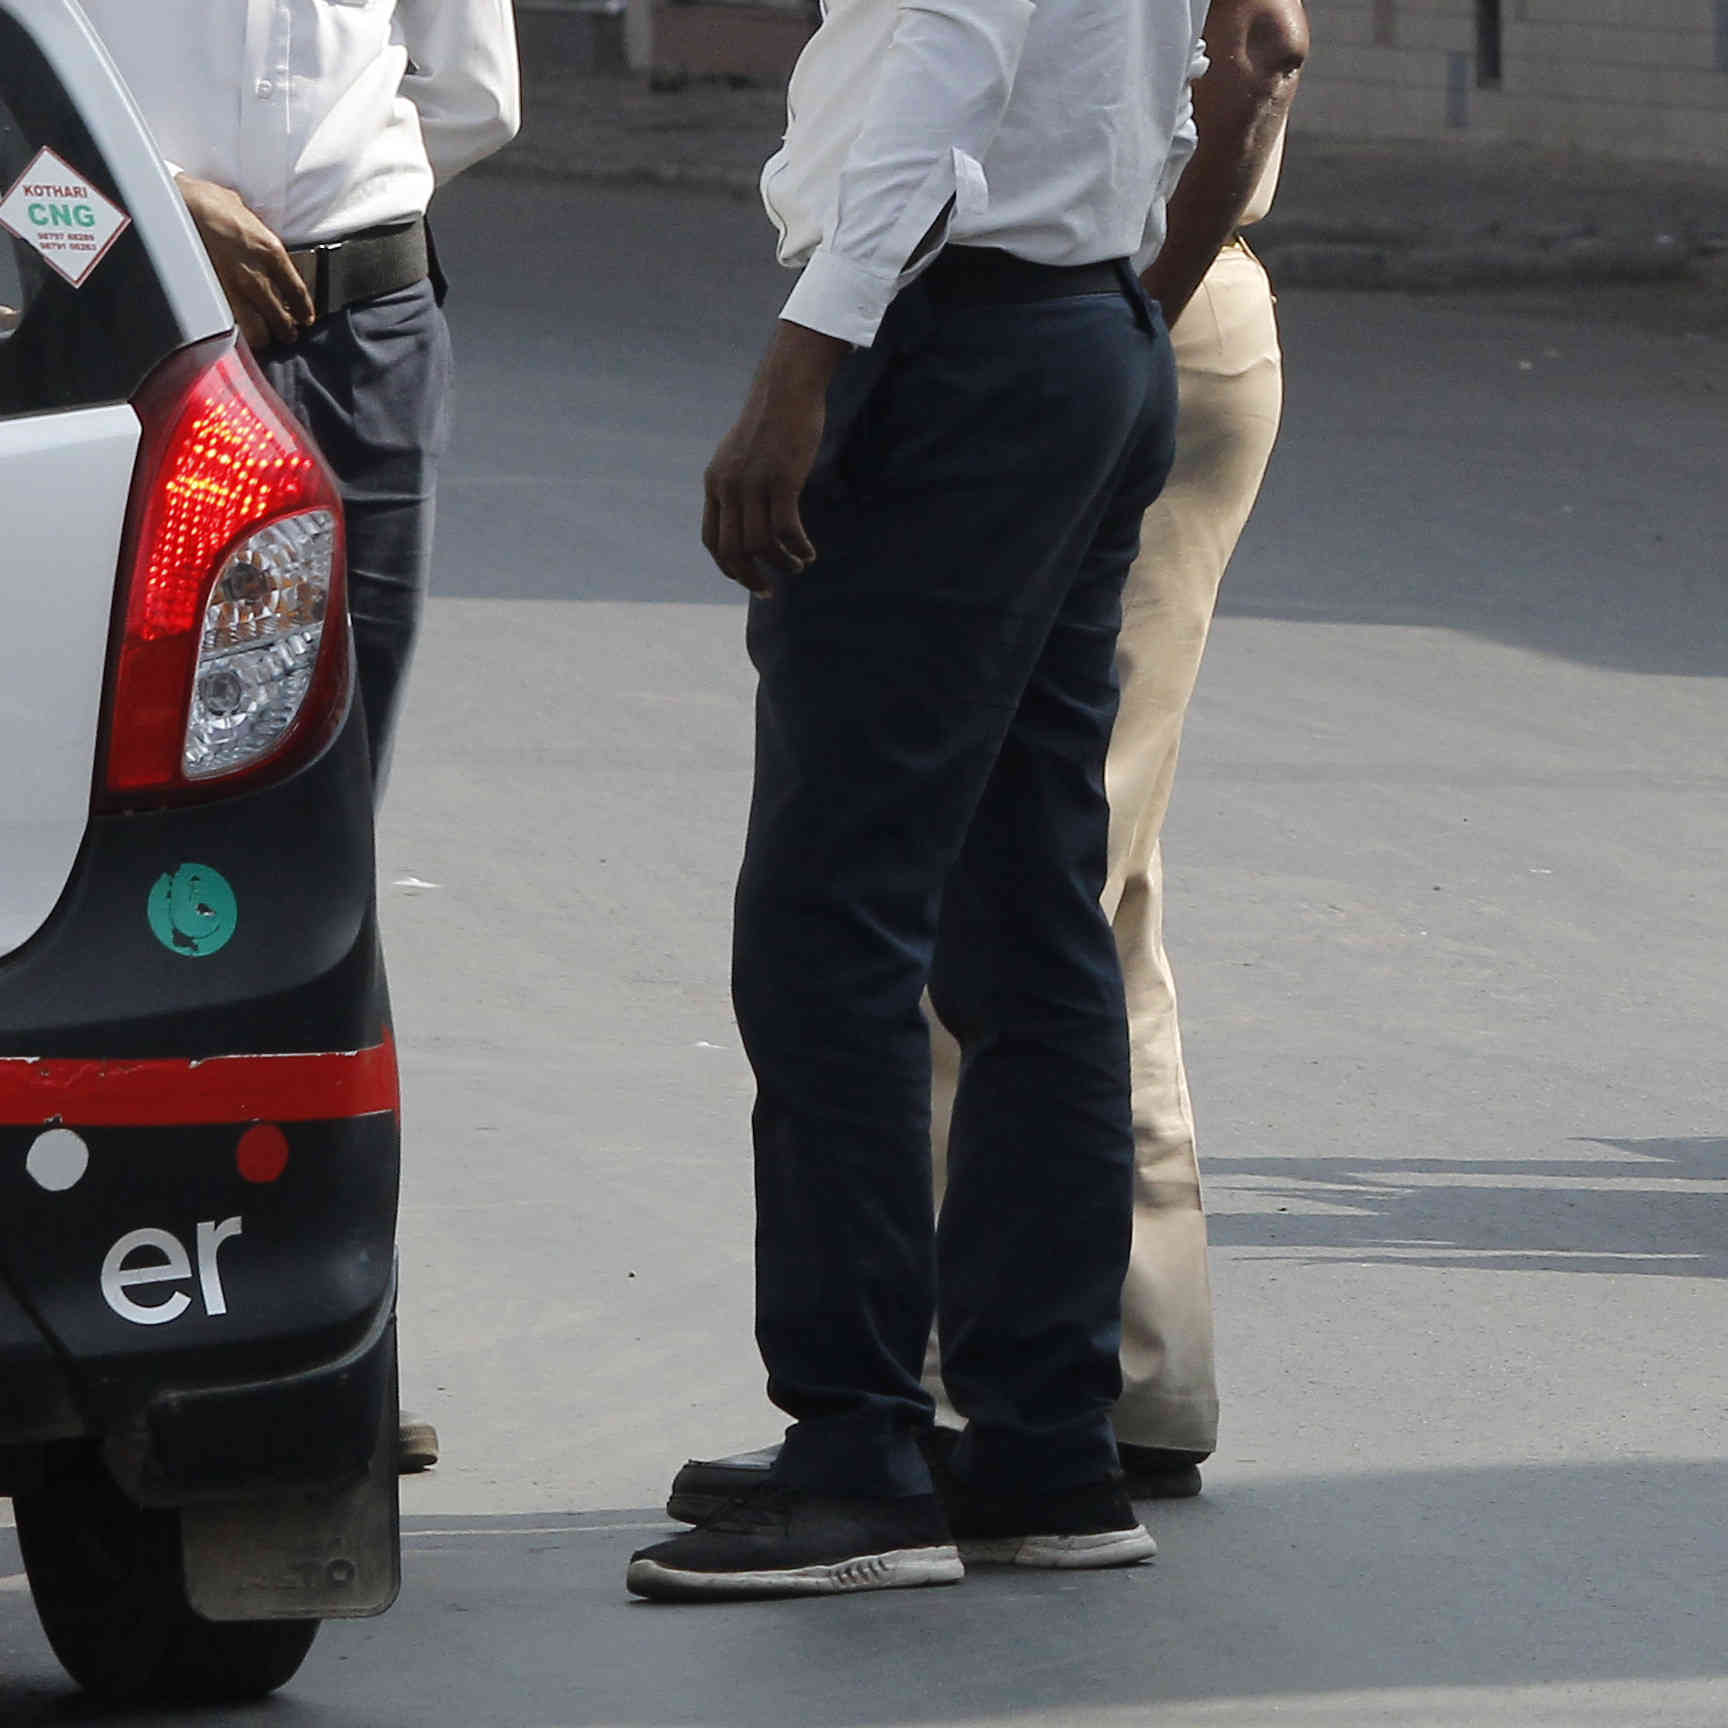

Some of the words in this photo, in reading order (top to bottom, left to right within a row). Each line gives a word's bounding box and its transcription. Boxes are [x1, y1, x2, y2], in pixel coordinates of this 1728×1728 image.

[23, 184, 88, 198] KOTHARI
[28, 203, 96, 227] CNG
[100, 1215, 243, 1325] er
